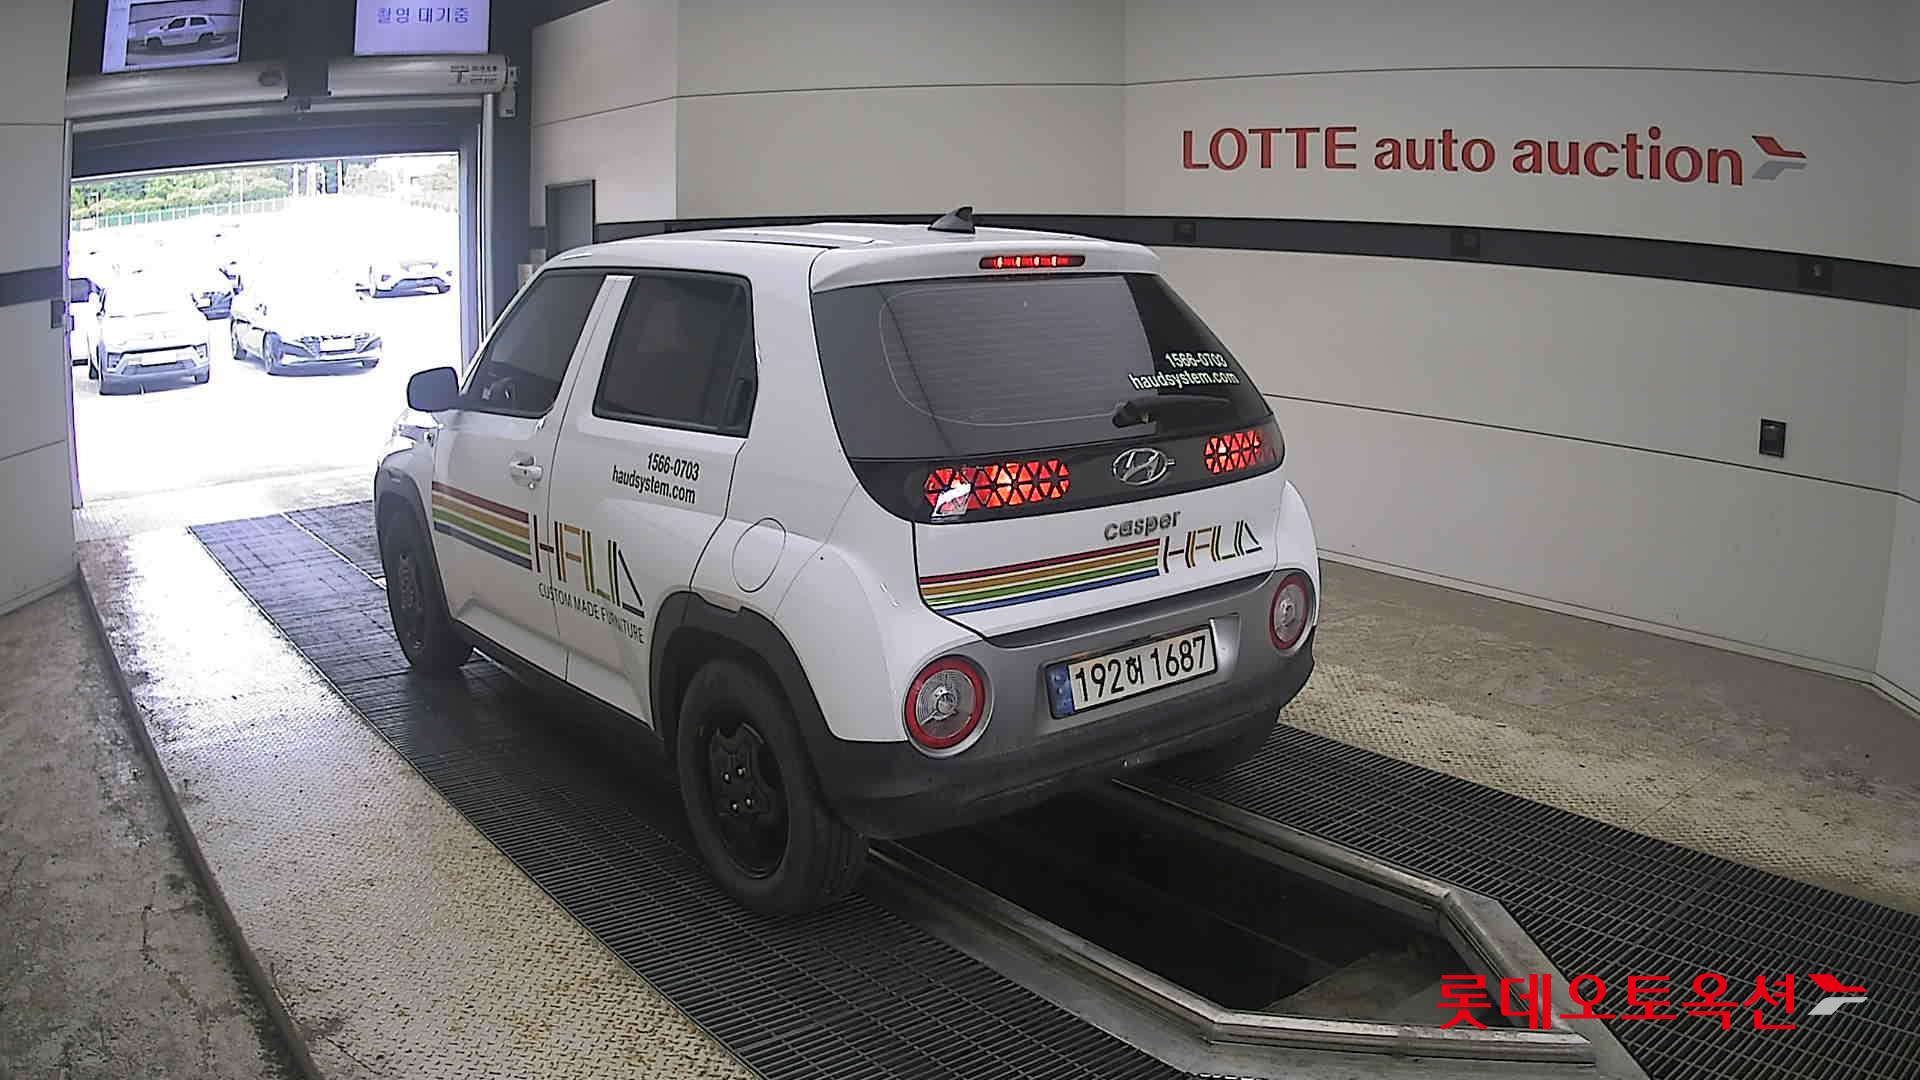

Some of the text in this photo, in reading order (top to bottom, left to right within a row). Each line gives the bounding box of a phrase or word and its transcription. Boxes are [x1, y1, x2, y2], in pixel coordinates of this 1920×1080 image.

[418, 7, 469, 24] 대기중
[1182, 125, 1744, 186] LOTTE auto auction
[1164, 352, 1227, 369] 1566-0703
[1128, 370, 1240, 390] haudsystem.com
[647, 452, 700, 481] 1566-0703
[612, 465, 696, 504] haudsystem.com
[1103, 510, 1181, 541] casper
[538, 582, 573, 609] CUSTOM
[573, 596, 601, 621] MADE
[1074, 635, 1207, 702] 192허 1687
